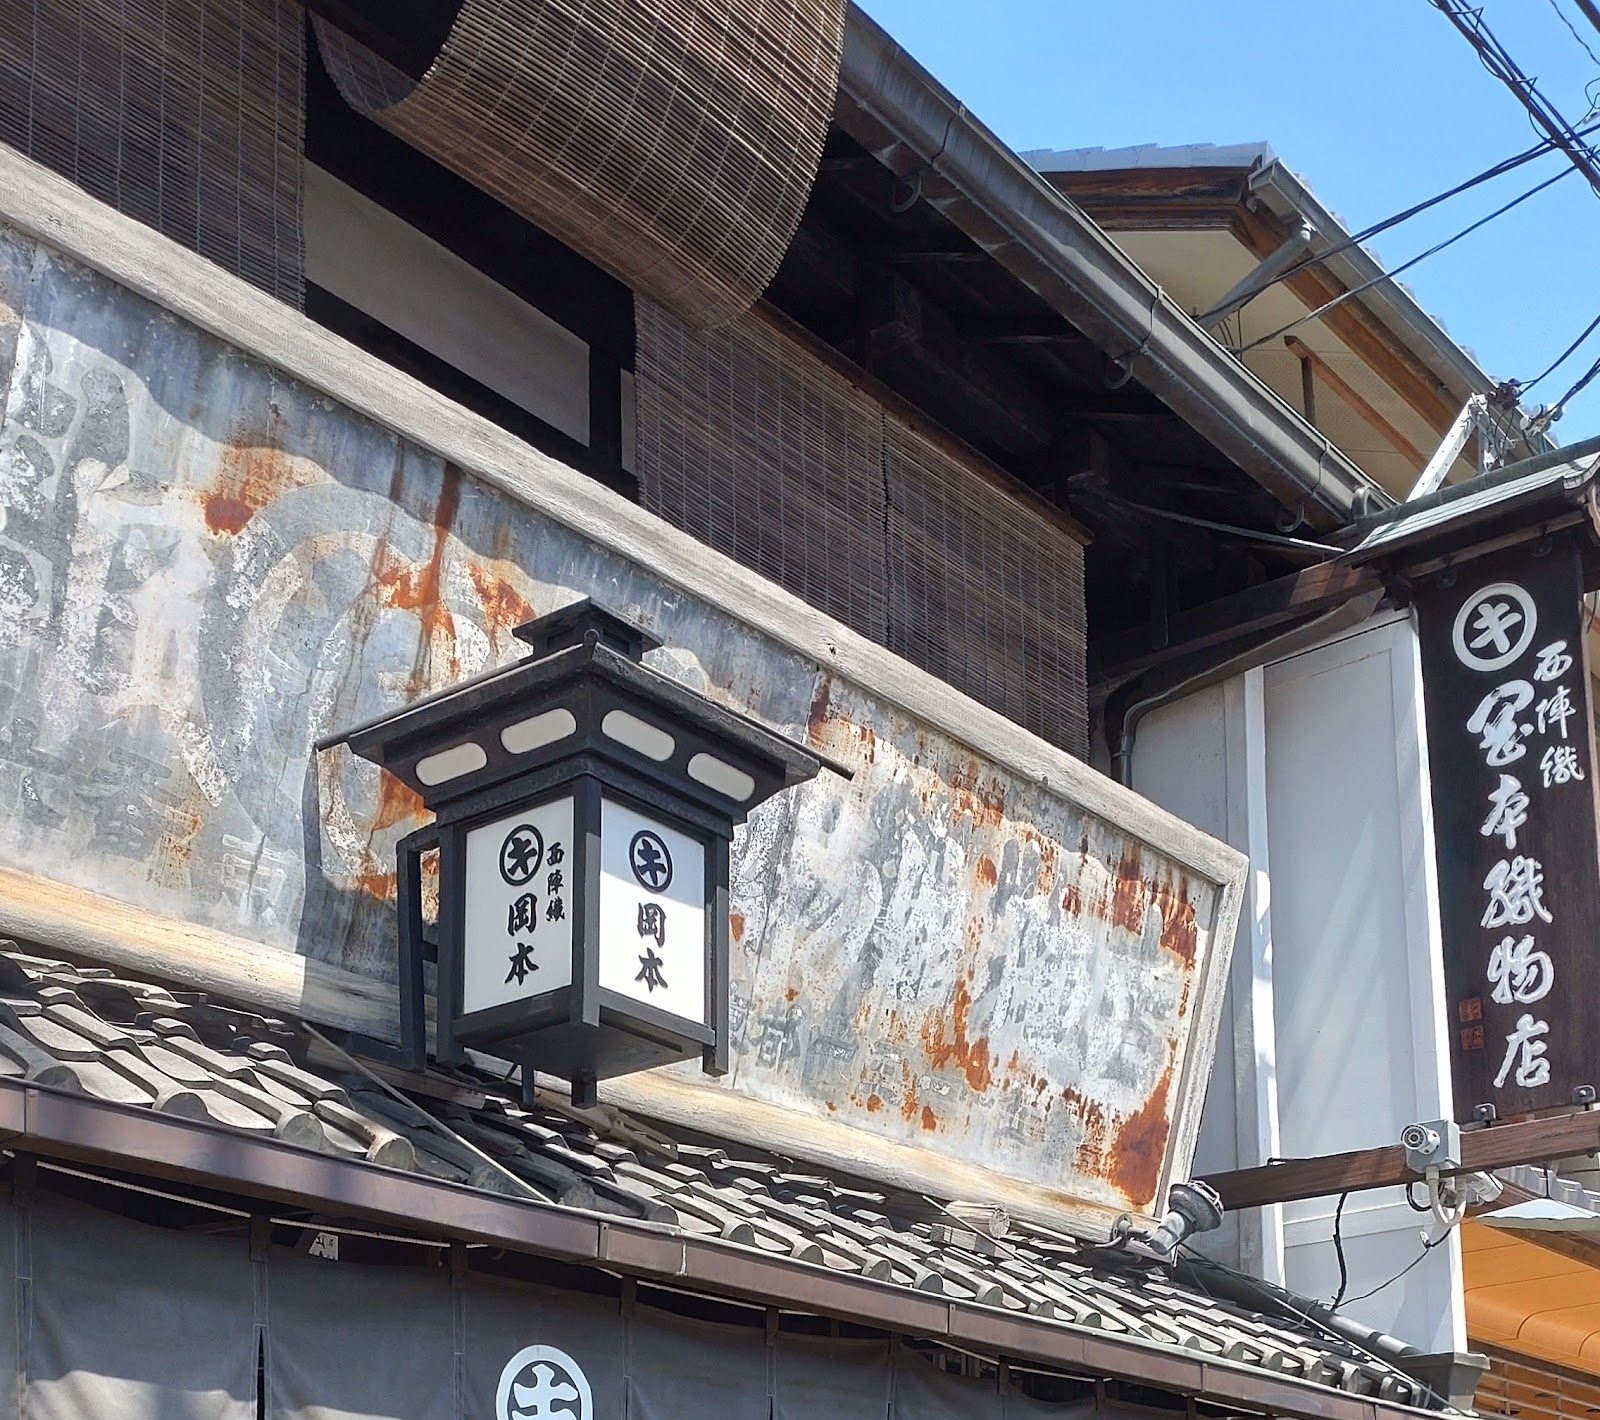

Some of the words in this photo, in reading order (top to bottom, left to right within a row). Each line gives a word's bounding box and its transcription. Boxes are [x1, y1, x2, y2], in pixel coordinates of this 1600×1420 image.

[1533, 640, 1585, 788] 西陣織
[546, 841, 566, 922] 西陣織
[1466, 679, 1554, 1088] 岡本織物店
[504, 892, 540, 986] 岡本
[634, 902, 669, 993] 岡本
